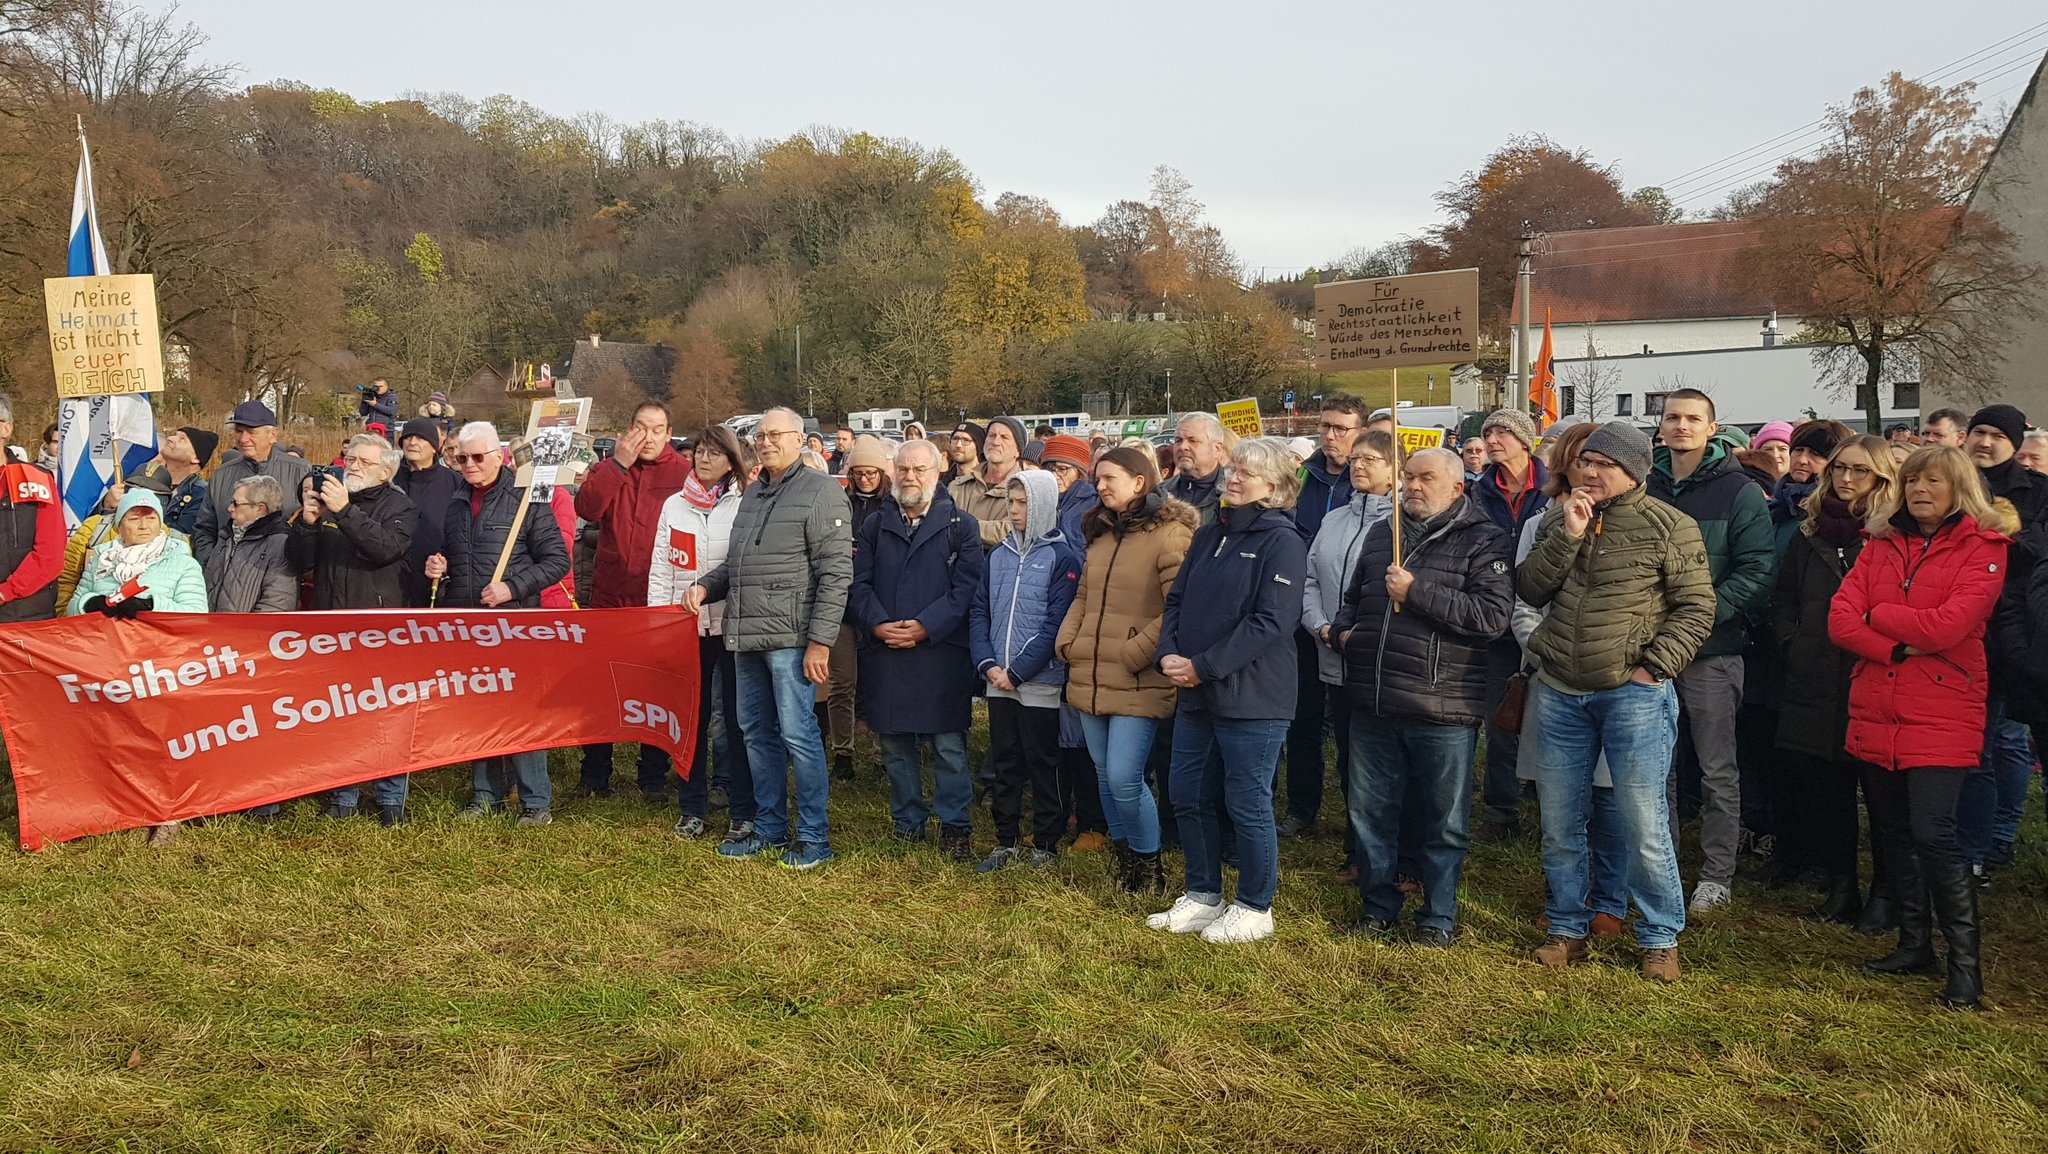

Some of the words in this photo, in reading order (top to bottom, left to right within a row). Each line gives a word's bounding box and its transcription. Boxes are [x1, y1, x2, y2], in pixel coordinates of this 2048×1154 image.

[73, 289, 132, 308] Meine
[1373, 282, 1399, 298] Für
[1338, 298, 1424, 318] Demokratie
[60, 309, 139, 329] Heimat
[1328, 306, 1462, 331] Rechtsstaatlichkeit
[53, 331, 76, 352] ist
[86, 329, 142, 348] nicht
[1328, 330, 1364, 344] Würde
[1370, 329, 1390, 340] des
[1394, 325, 1462, 339] Menschen
[1330, 345, 1380, 361] Erhaltung
[1385, 345, 1396, 355] d.
[1399, 339, 1472, 353] Grundrechte
[74, 352, 129, 370] euer
[62, 368, 146, 394] REICH
[1220, 408, 1256, 419] WEMDING
[1397, 432, 1437, 447] KEIN
[18, 481, 50, 500] SPD
[56, 645, 256, 704] Freiheit,
[268, 618, 586, 661] Gerechtigkeit
[167, 704, 259, 760] und
[272, 666, 516, 730] Solidarität
